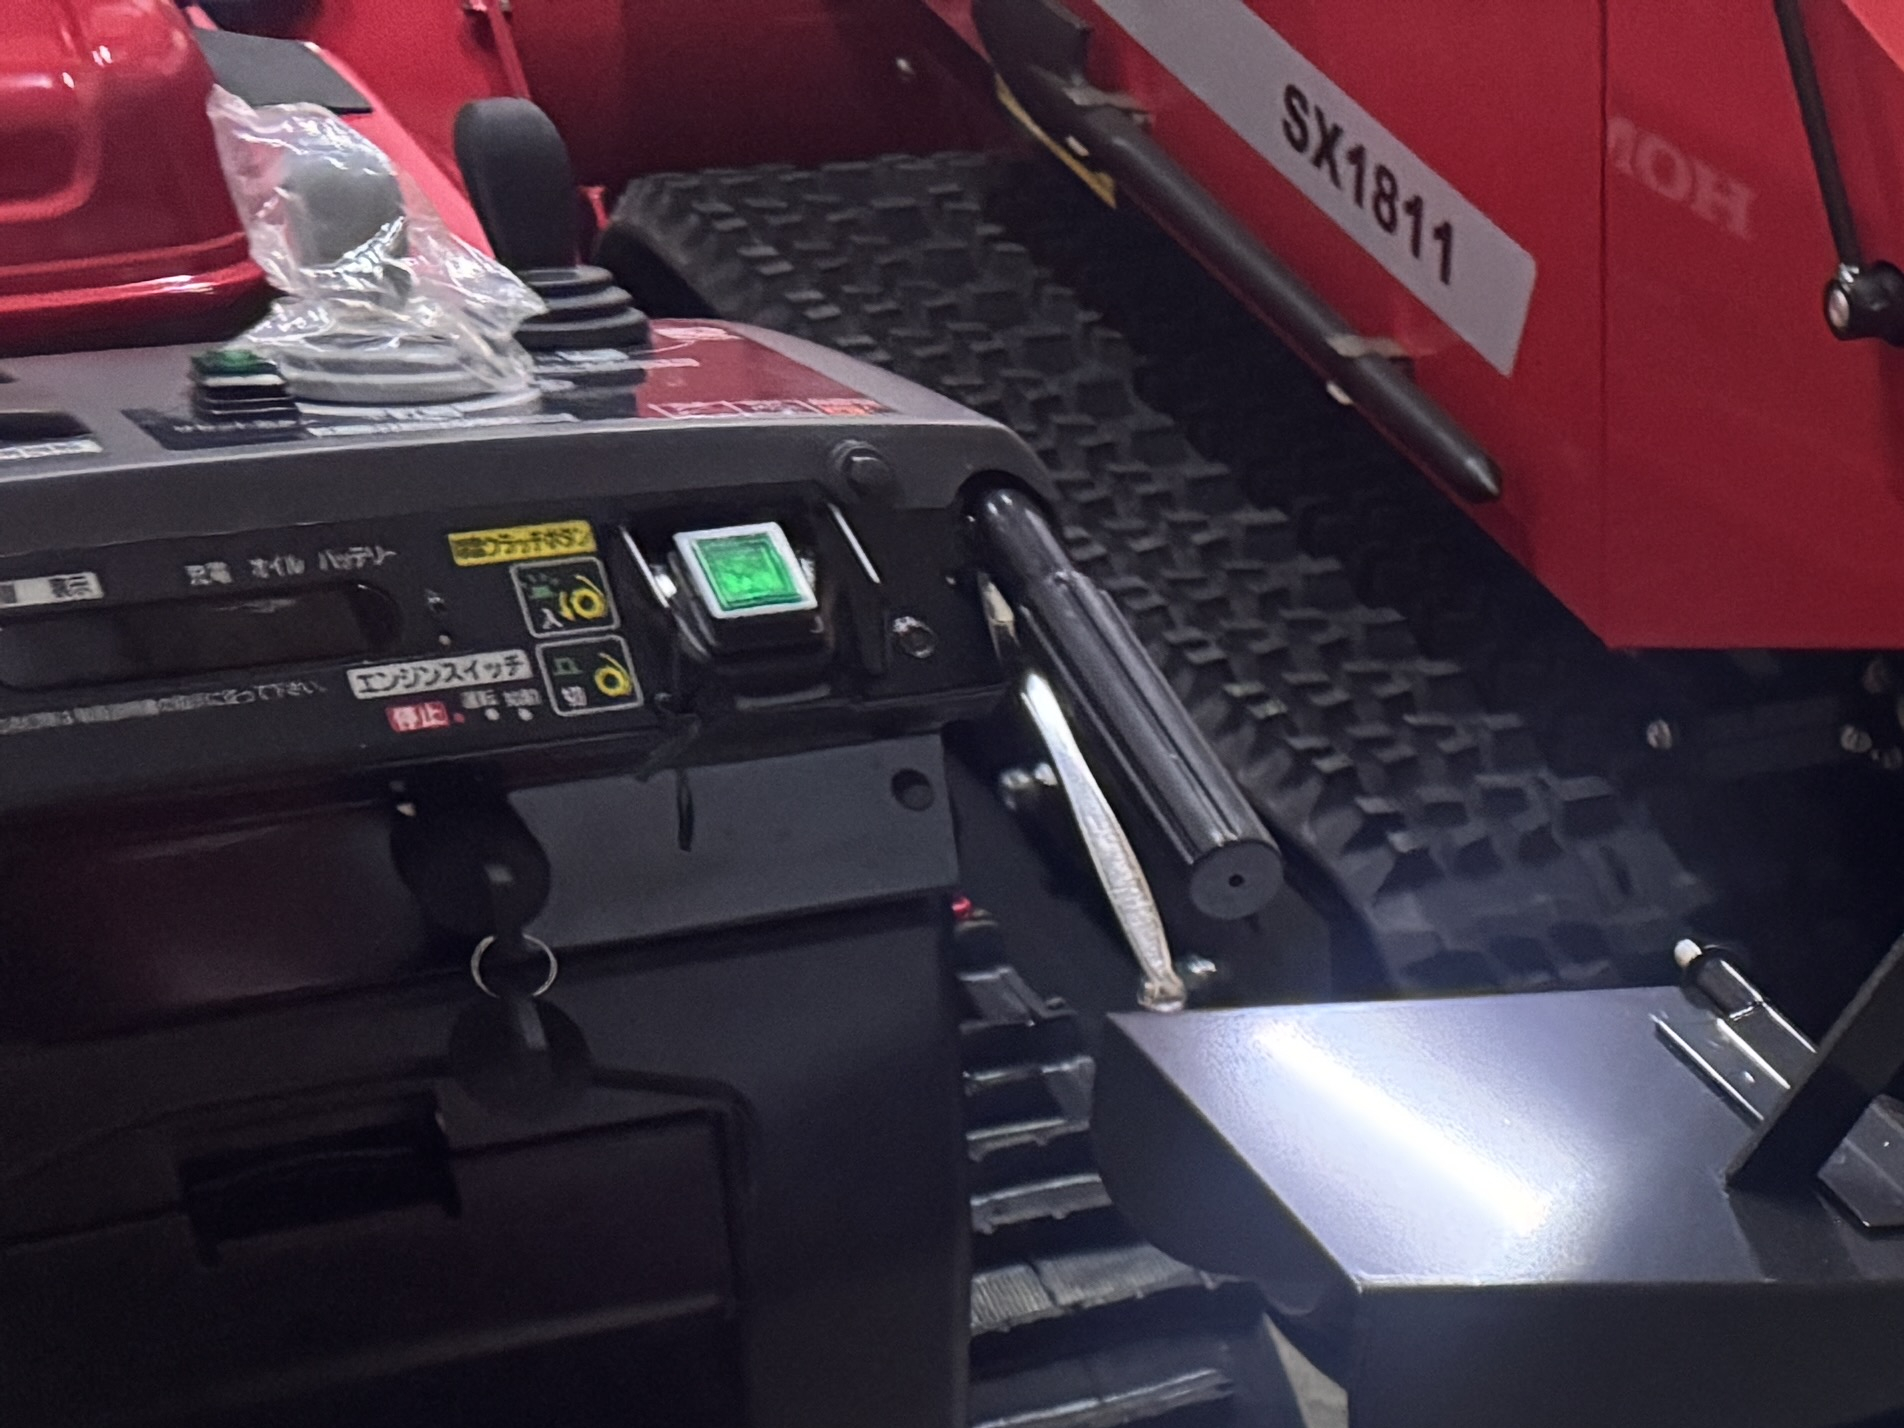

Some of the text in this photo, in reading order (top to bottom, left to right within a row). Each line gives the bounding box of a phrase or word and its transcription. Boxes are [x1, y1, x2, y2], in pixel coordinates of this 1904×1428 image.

[1281, 83, 1454, 286] SX1811
[356, 653, 526, 693] エンジンスイッチ
